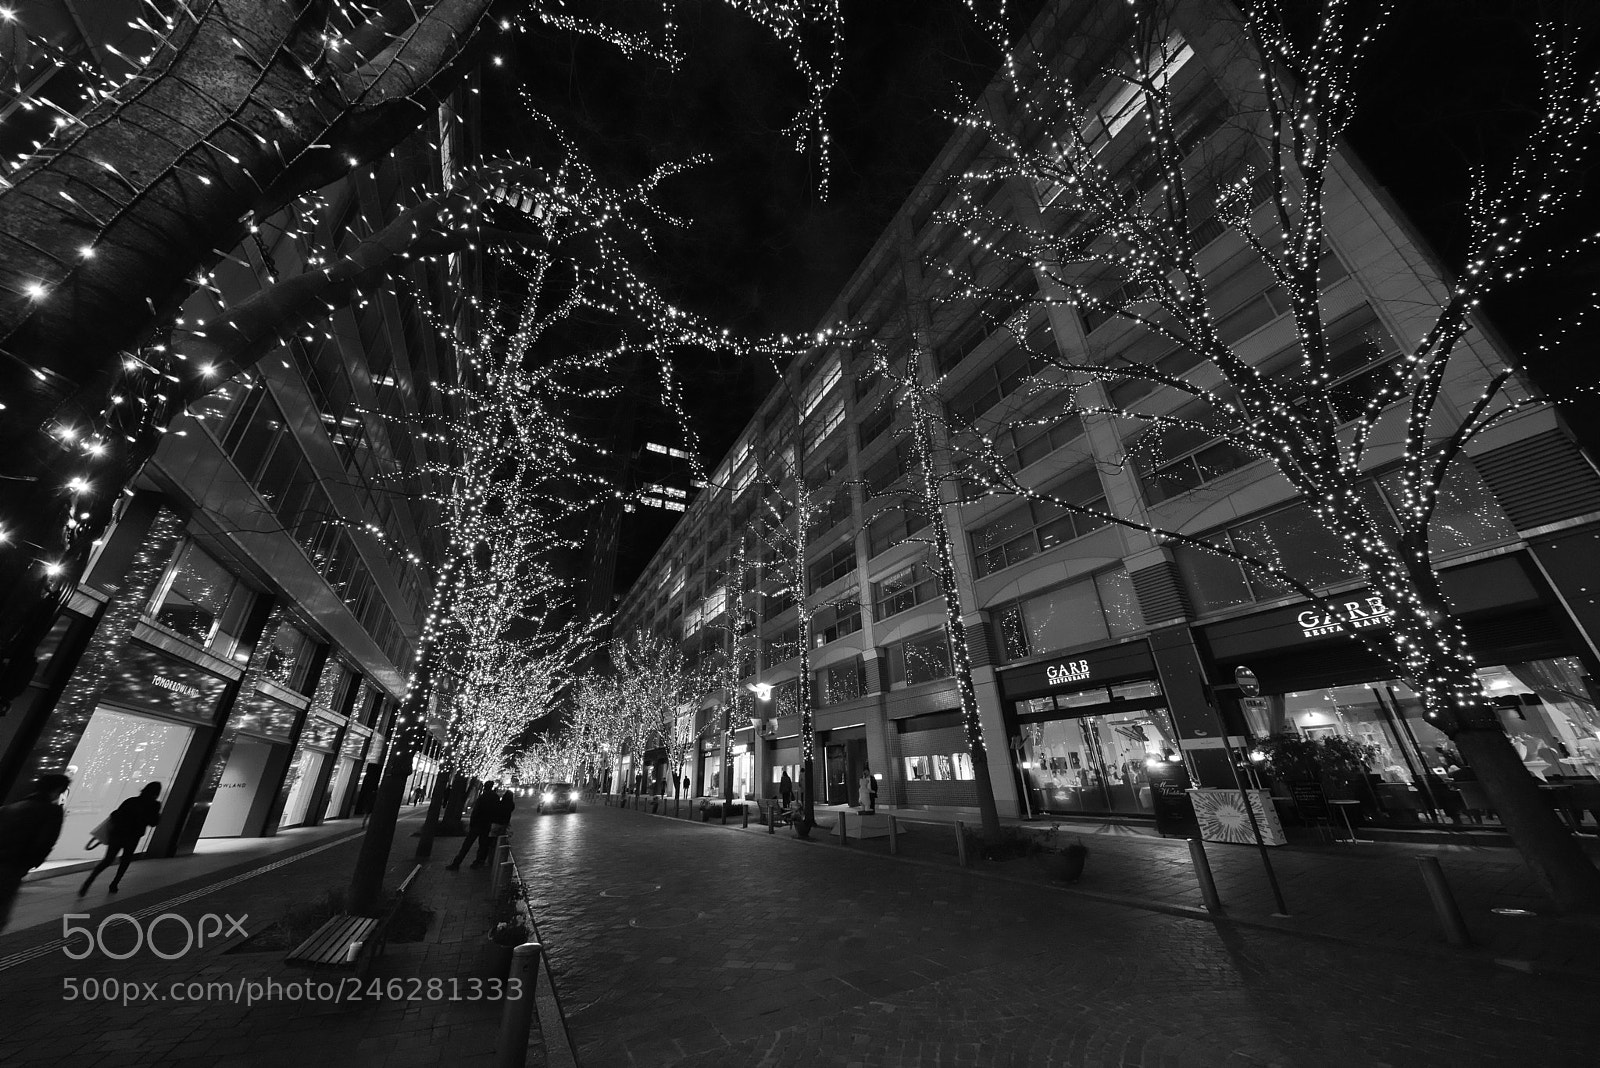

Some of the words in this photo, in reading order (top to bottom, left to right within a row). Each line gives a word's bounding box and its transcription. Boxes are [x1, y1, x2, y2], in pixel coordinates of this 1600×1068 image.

[1303, 615, 1391, 638] RESTARANT
[1046, 659, 1089, 678] GARB
[151, 675, 199, 696] TOMORROWLAND
[1048, 673, 1090, 685] RESTAURANT
